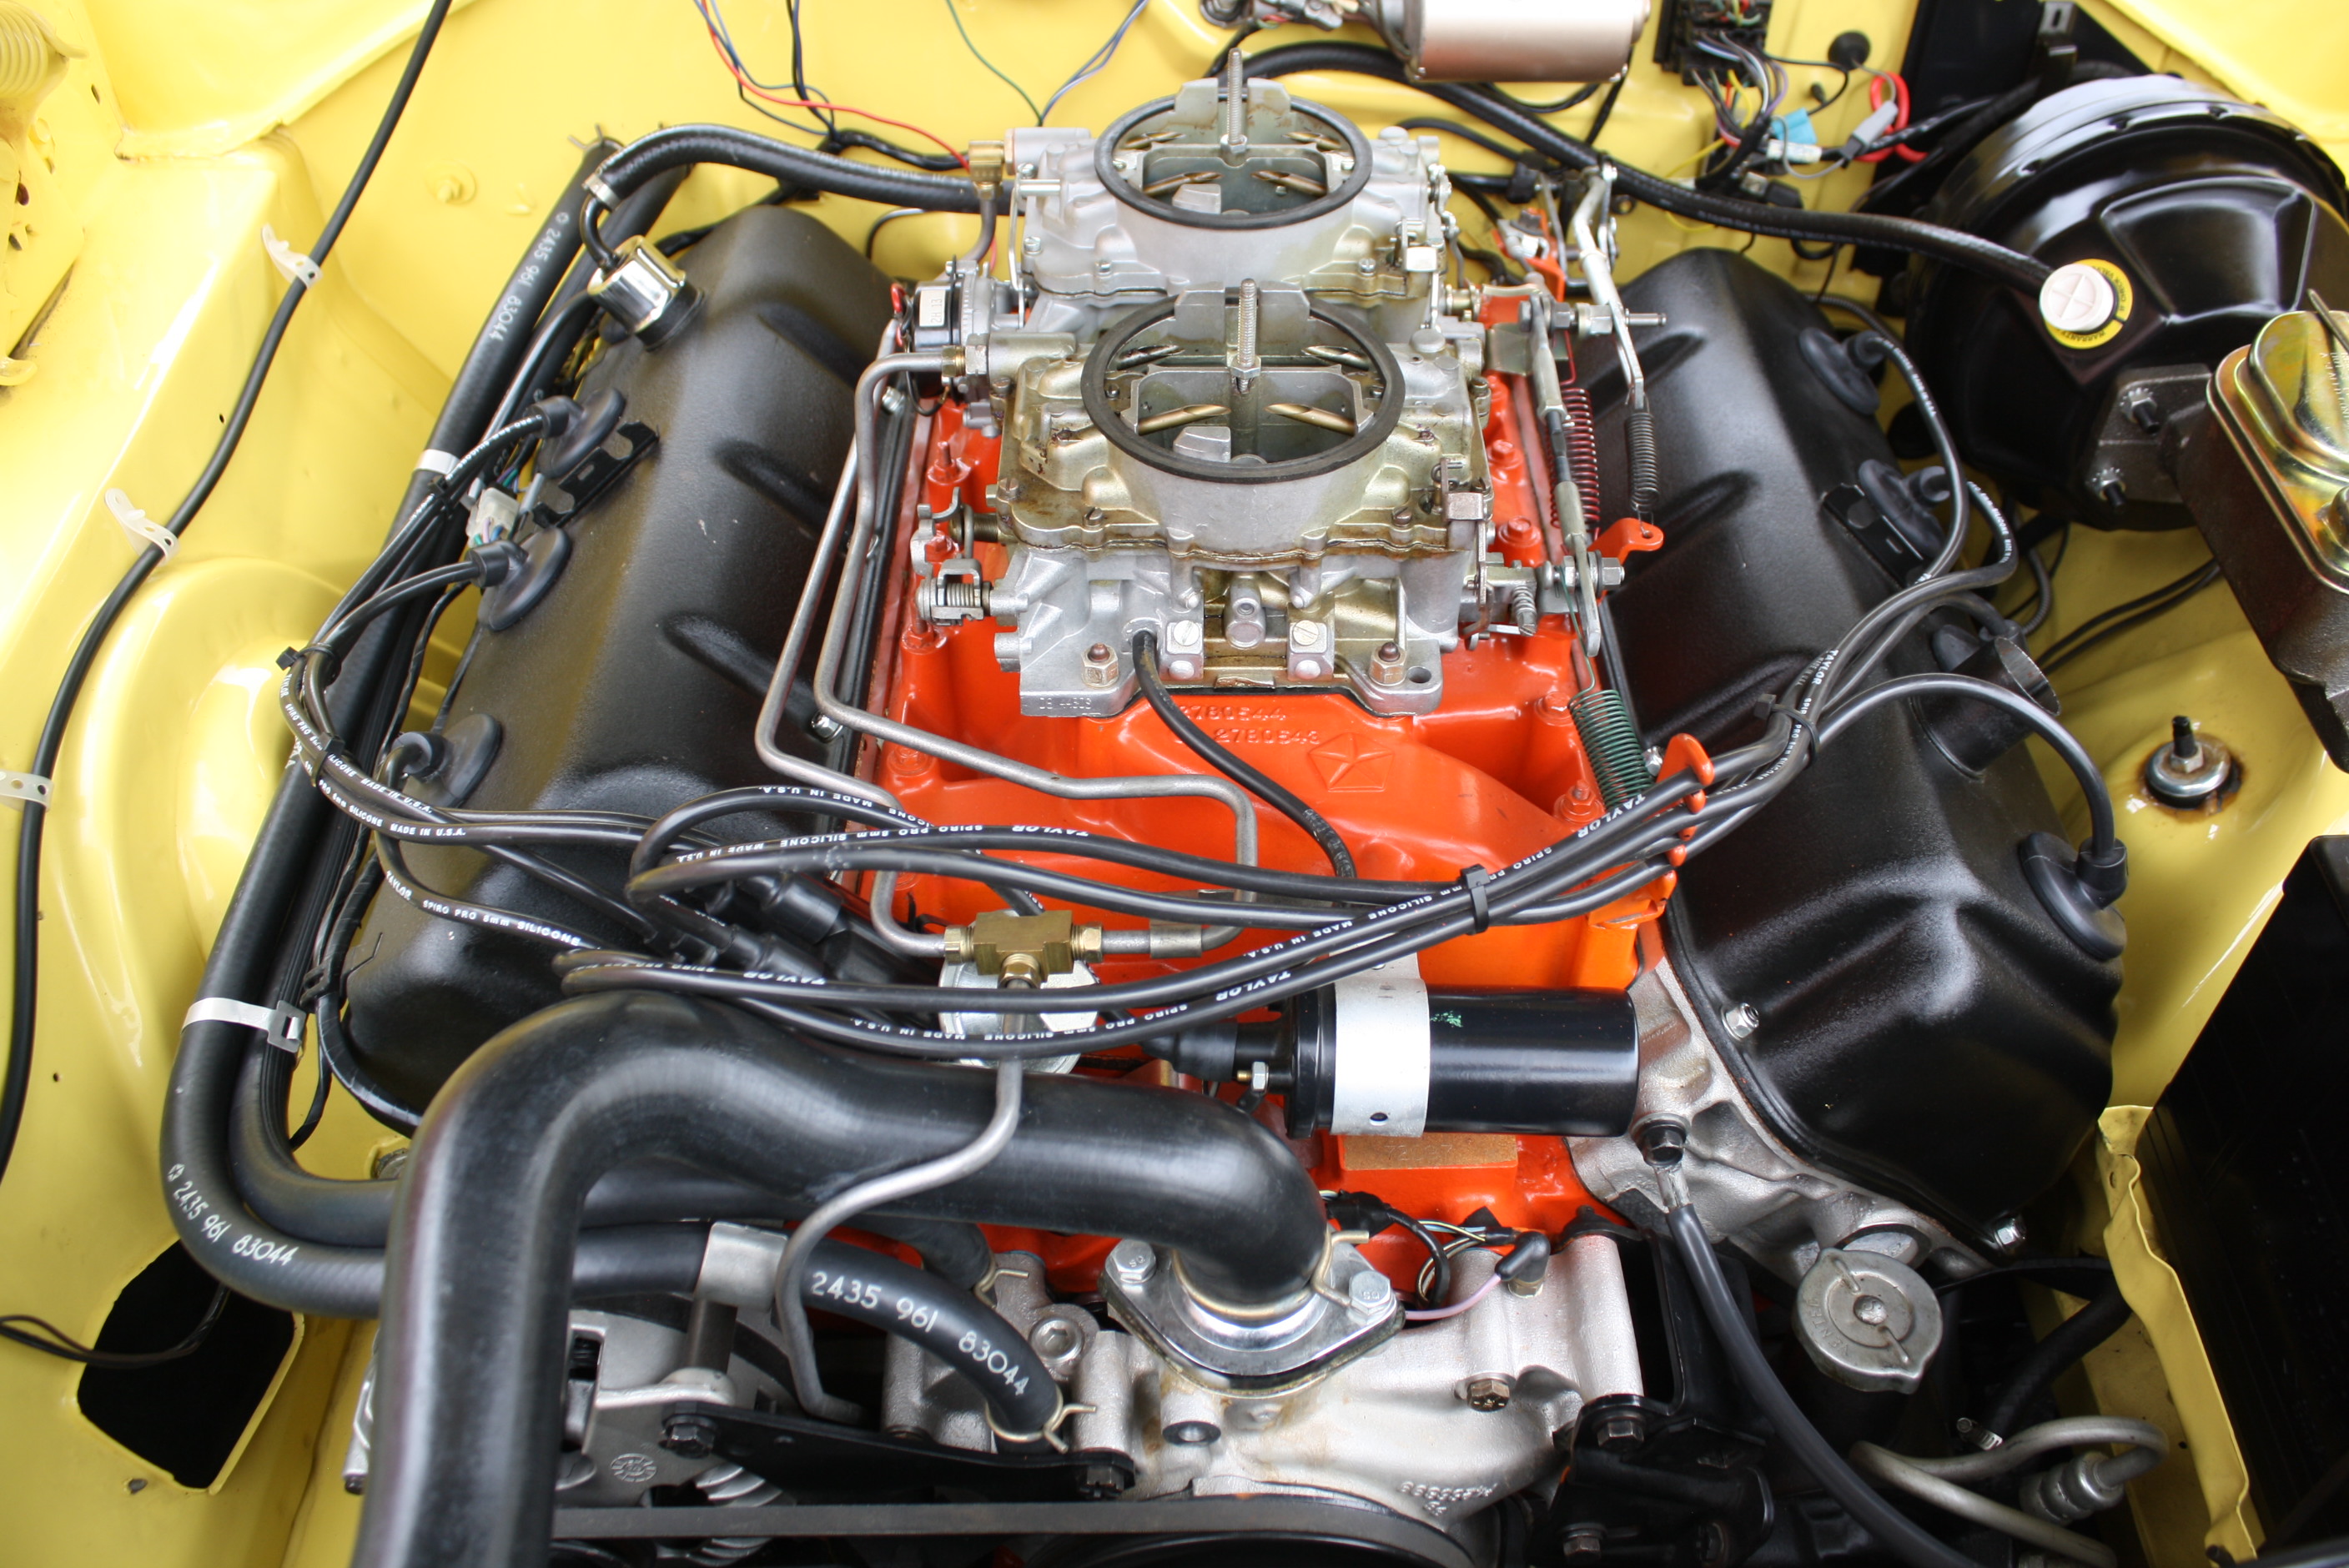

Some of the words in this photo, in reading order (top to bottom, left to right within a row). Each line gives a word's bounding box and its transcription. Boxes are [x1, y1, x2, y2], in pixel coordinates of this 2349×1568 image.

[534, 228, 561, 262] 2435
[517, 265, 540, 287] 961
[489, 295, 522, 341] 83044
[1811, 649, 1839, 686] TAYLOR
[1799, 697, 1812, 715] SPIR
[1791, 724, 1802, 738] PRO
[285, 703, 299, 721] SPIRO
[297, 722, 311, 735] PRO
[328, 753, 357, 777] ILICONE
[360, 778, 385, 792] MADE
[388, 791, 402, 800] IN
[404, 797, 433, 814] U.S.A.
[758, 785, 801, 795] U.S.A.
[809, 788, 824, 797] IN
[832, 792, 873, 807] MADE
[349, 805, 385, 827] SILICONE
[390, 822, 416, 835] MADE
[420, 827, 432, 837] IN
[435, 827, 466, 837] U.S.A.
[888, 807, 935, 827] ICONE
[1577, 793, 1647, 838] TAYLOR
[856, 829, 889, 839] 8mm
[898, 827, 929, 837] PRO
[938, 824, 983, 832] SPIRO
[1012, 824, 1089, 837] TAYLOR
[727, 842, 765, 854] MADE
[779, 834, 848, 848] SILICONE
[709, 848, 722, 857] IN
[1512, 847, 1552, 870] SPIRO
[1488, 869, 1506, 881] PR
[386, 870, 413, 901] TAYLOR
[423, 899, 450, 915] SPIRO
[455, 908, 477, 920] PRO
[483, 914, 511, 927] 8mm
[517, 920, 582, 947] SILICONE
[1367, 895, 1433, 920] SILICONE
[1312, 920, 1353, 937] MADE
[1290, 935, 1306, 945] IN
[1243, 942, 1284, 959] U.S.A.
[1215, 970, 1292, 1002] TAYLOR
[1144, 1003, 1189, 1021] SPIRO
[850, 1018, 891, 1033] U.S.A.
[1064, 1026, 1097, 1035] 8mm
[1105, 1017, 1135, 1030] PRO
[898, 1026, 915, 1037] IN
[923, 1031, 966, 1041] MADE
[983, 1031, 1054, 1042] SILICONE
[173, 1180, 210, 1221] 2435
[201, 1214, 233, 1244] 961
[232, 1234, 300, 1267] 83044
[810, 1270, 883, 1309] 2435
[896, 1297, 938, 1333] 961
[958, 1329, 1030, 1397] 83044
